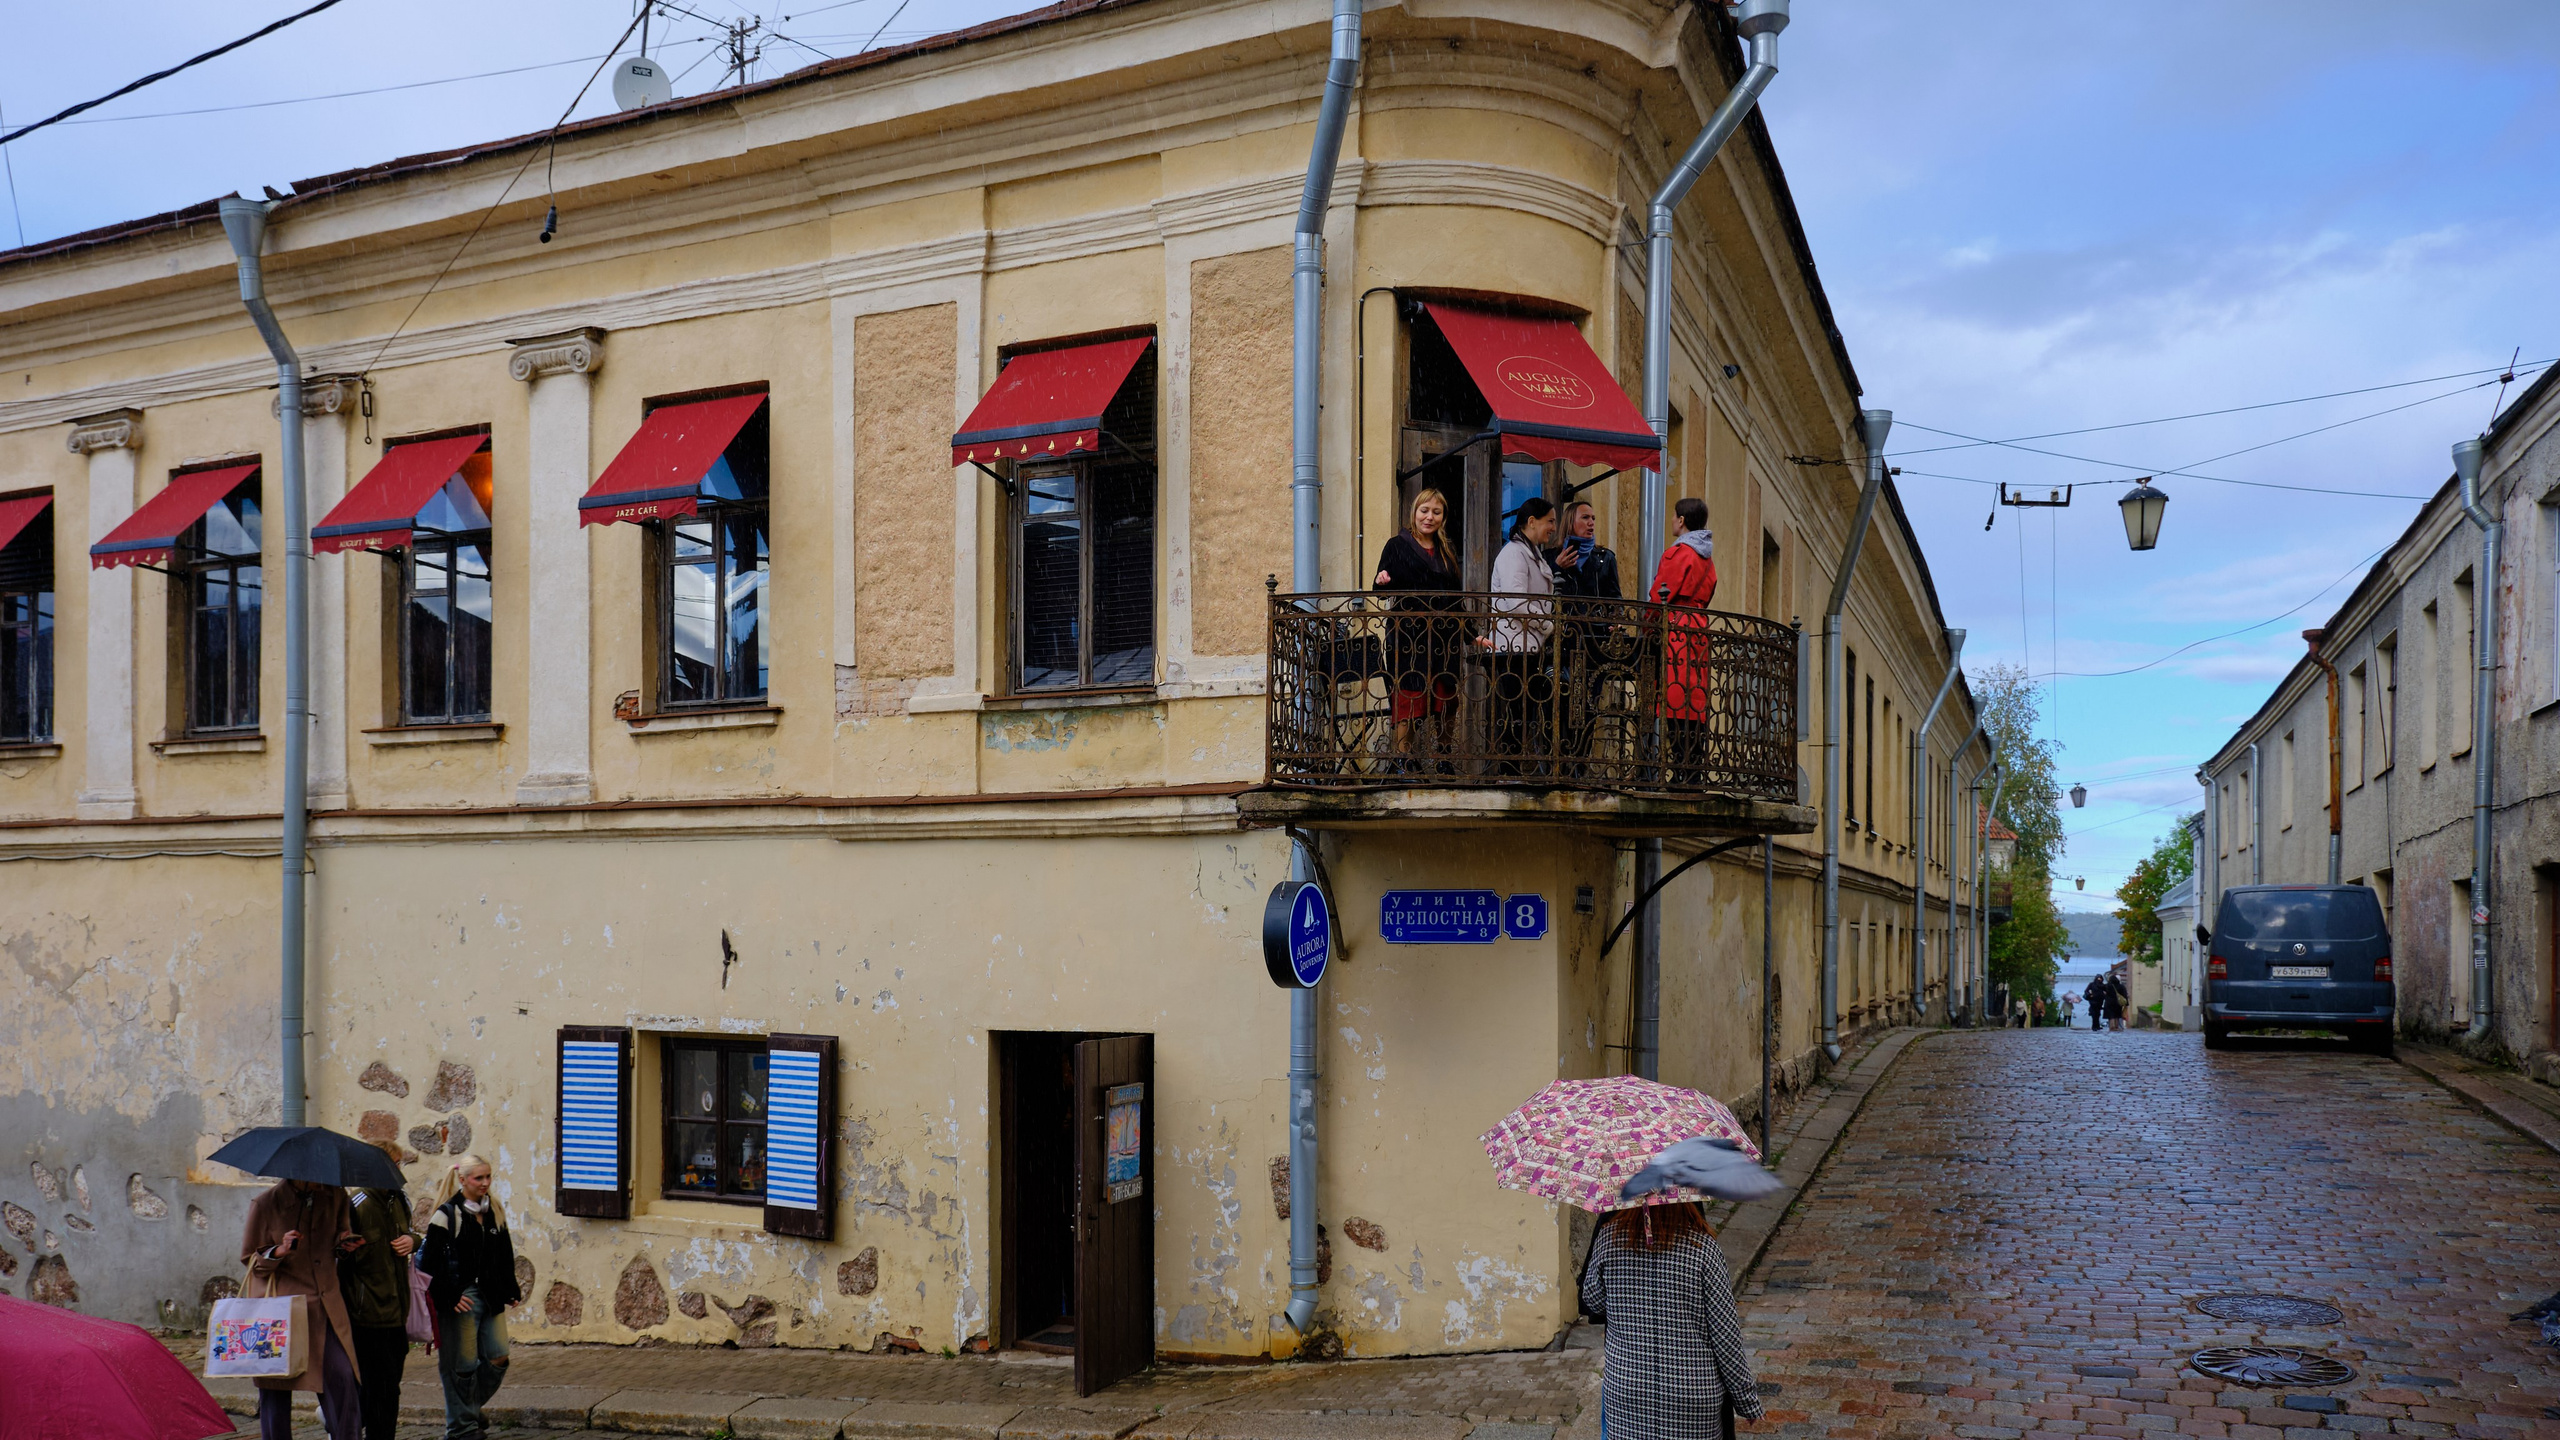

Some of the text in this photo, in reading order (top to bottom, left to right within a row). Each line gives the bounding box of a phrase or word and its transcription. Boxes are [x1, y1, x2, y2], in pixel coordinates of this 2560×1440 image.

[1507, 371, 1579, 388] AUGUST
[1522, 383, 1582, 397] WAHL
[615, 505, 658, 518] JAZZ CAFE
[1391, 896, 1487, 909] улица
[1384, 911, 1498, 926] КРЕПОСТНАЯ
[1514, 904, 1536, 929] 8
[1395, 927, 1488, 938] 6 8
[1296, 934, 1326, 960] AURORA
